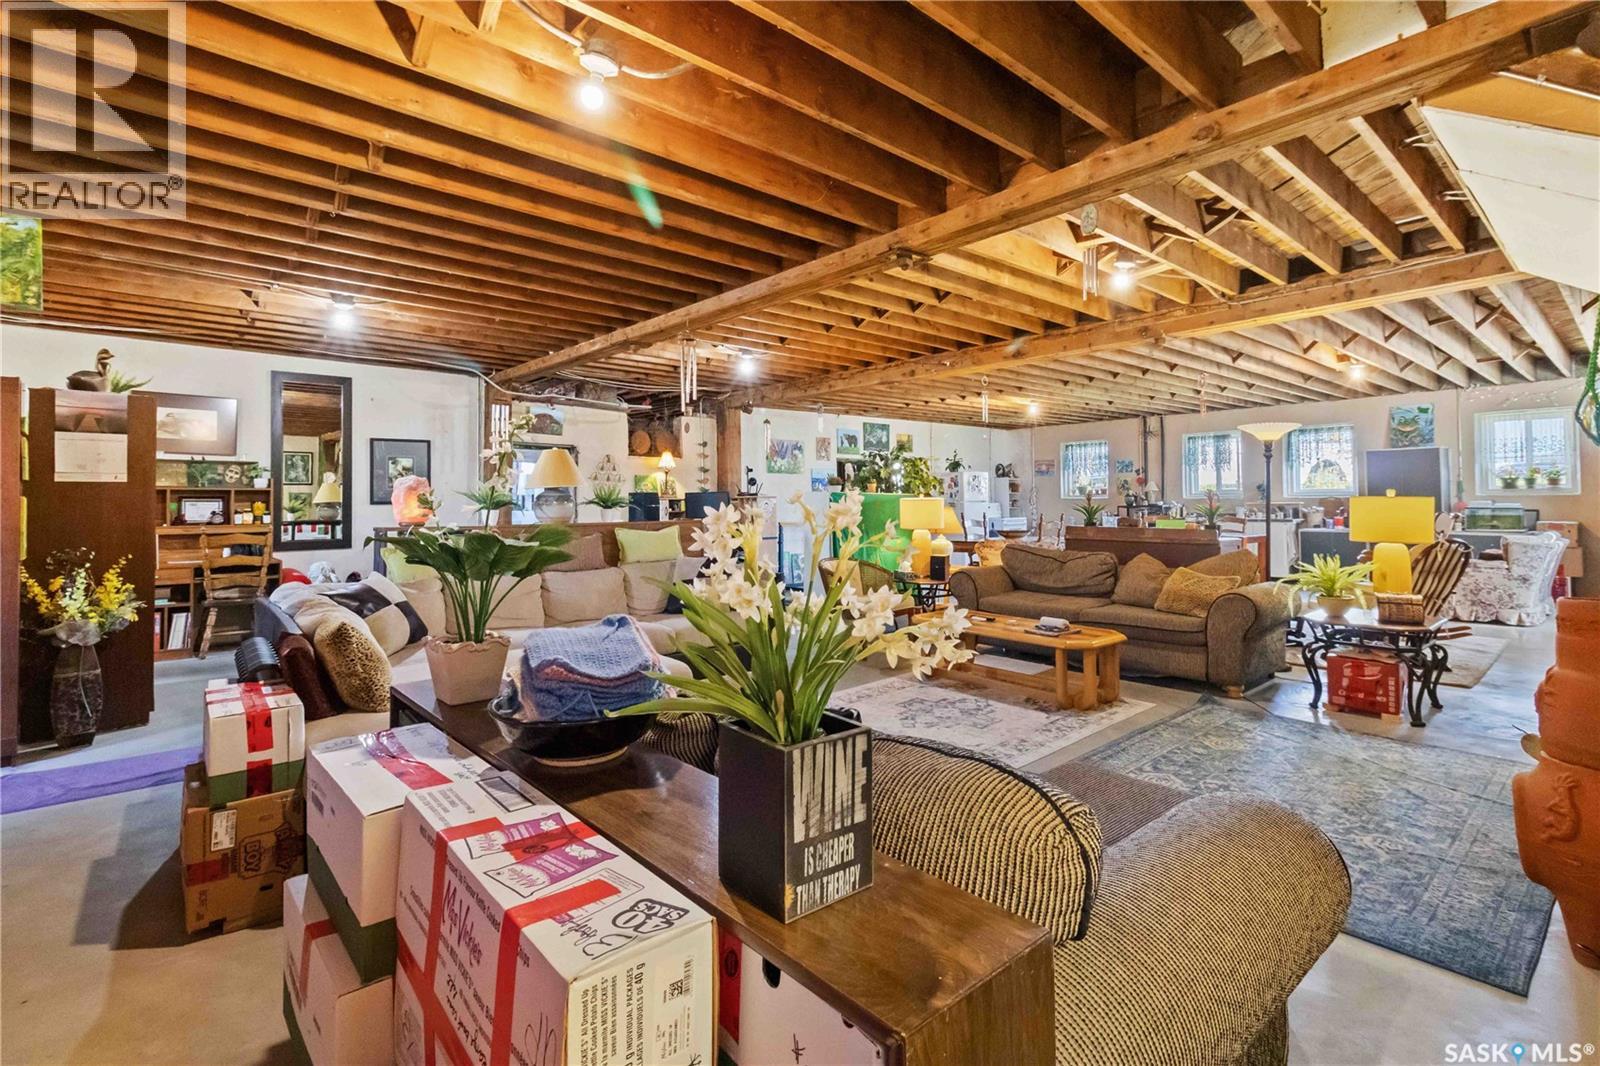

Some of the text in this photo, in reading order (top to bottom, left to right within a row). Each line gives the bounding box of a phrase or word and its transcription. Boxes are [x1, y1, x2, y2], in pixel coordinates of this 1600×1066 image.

[793, 733, 868, 844] WINE
[244, 840, 261, 872] BOY
[804, 832, 855, 878] IS CHEAPER
[795, 863, 861, 915] THAN THERAPY
[612, 909, 675, 934] 40
[634, 972, 644, 985] 40
[637, 962, 645, 970] g
[591, 984, 599, 1004] Chips
[626, 968, 634, 1007] PACKAGES
[637, 985, 644, 996] DE
[590, 1026, 598, 1051] Cooked
[626, 1007, 634, 1052] INDIVIDUAL
